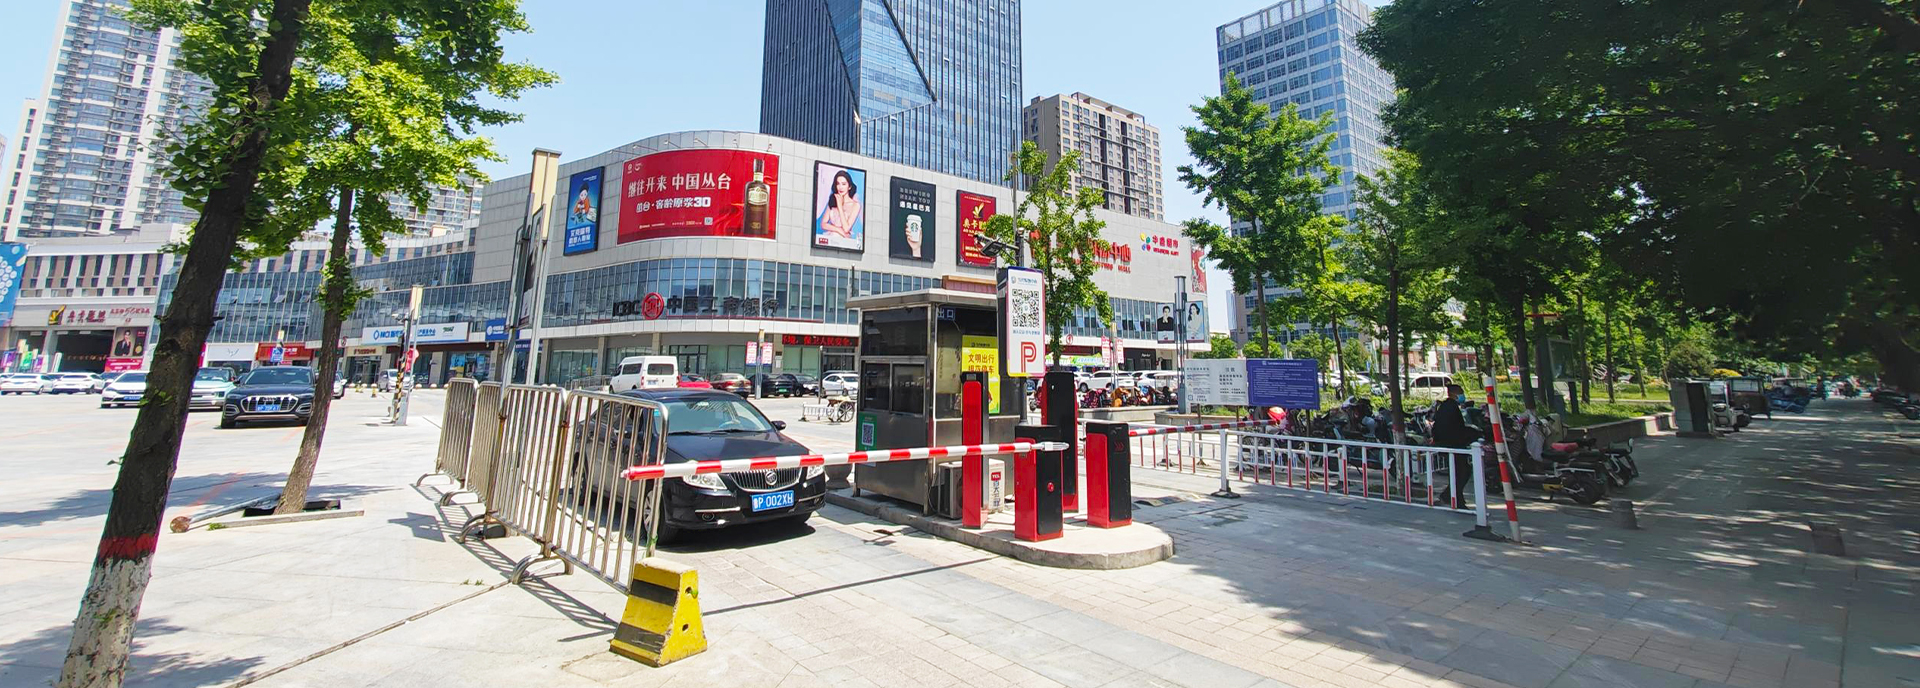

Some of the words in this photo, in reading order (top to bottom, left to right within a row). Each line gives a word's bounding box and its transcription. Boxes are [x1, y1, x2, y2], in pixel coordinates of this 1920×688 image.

[627, 174, 668, 198] 继往开来
[672, 172, 732, 190] 中国丛台
[612, 300, 640, 317] ICBC
[666, 295, 779, 318] 中国工商银行
[937, 308, 954, 318] 出口
[968, 353, 995, 364] 文明出行
